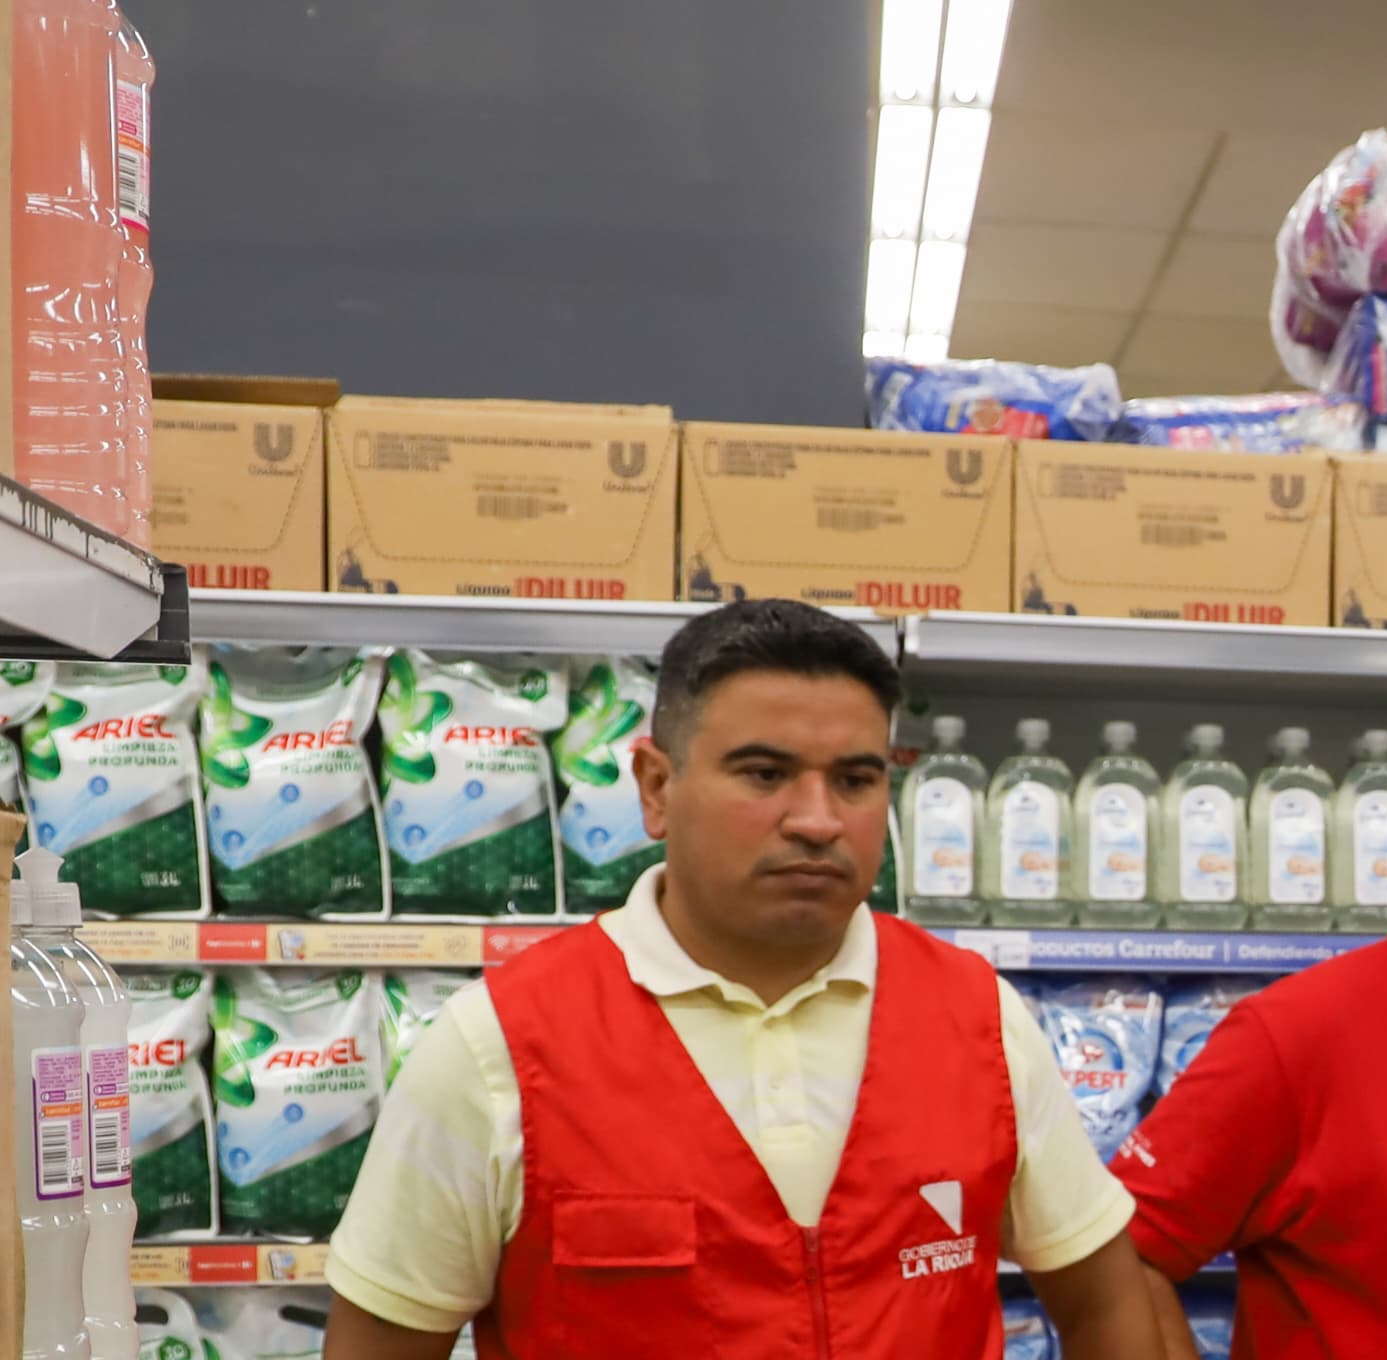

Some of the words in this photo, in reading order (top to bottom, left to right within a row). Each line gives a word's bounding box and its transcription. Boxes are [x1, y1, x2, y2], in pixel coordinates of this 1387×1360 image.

[865, 581, 962, 610] DILUIR
[72, 714, 176, 743] ARIEL
[261, 719, 360, 753] ARIEL
[1118, 937, 1216, 960] Carrefour
[265, 1036, 367, 1070] ARIEL
[902, 1257, 929, 1280] LA
